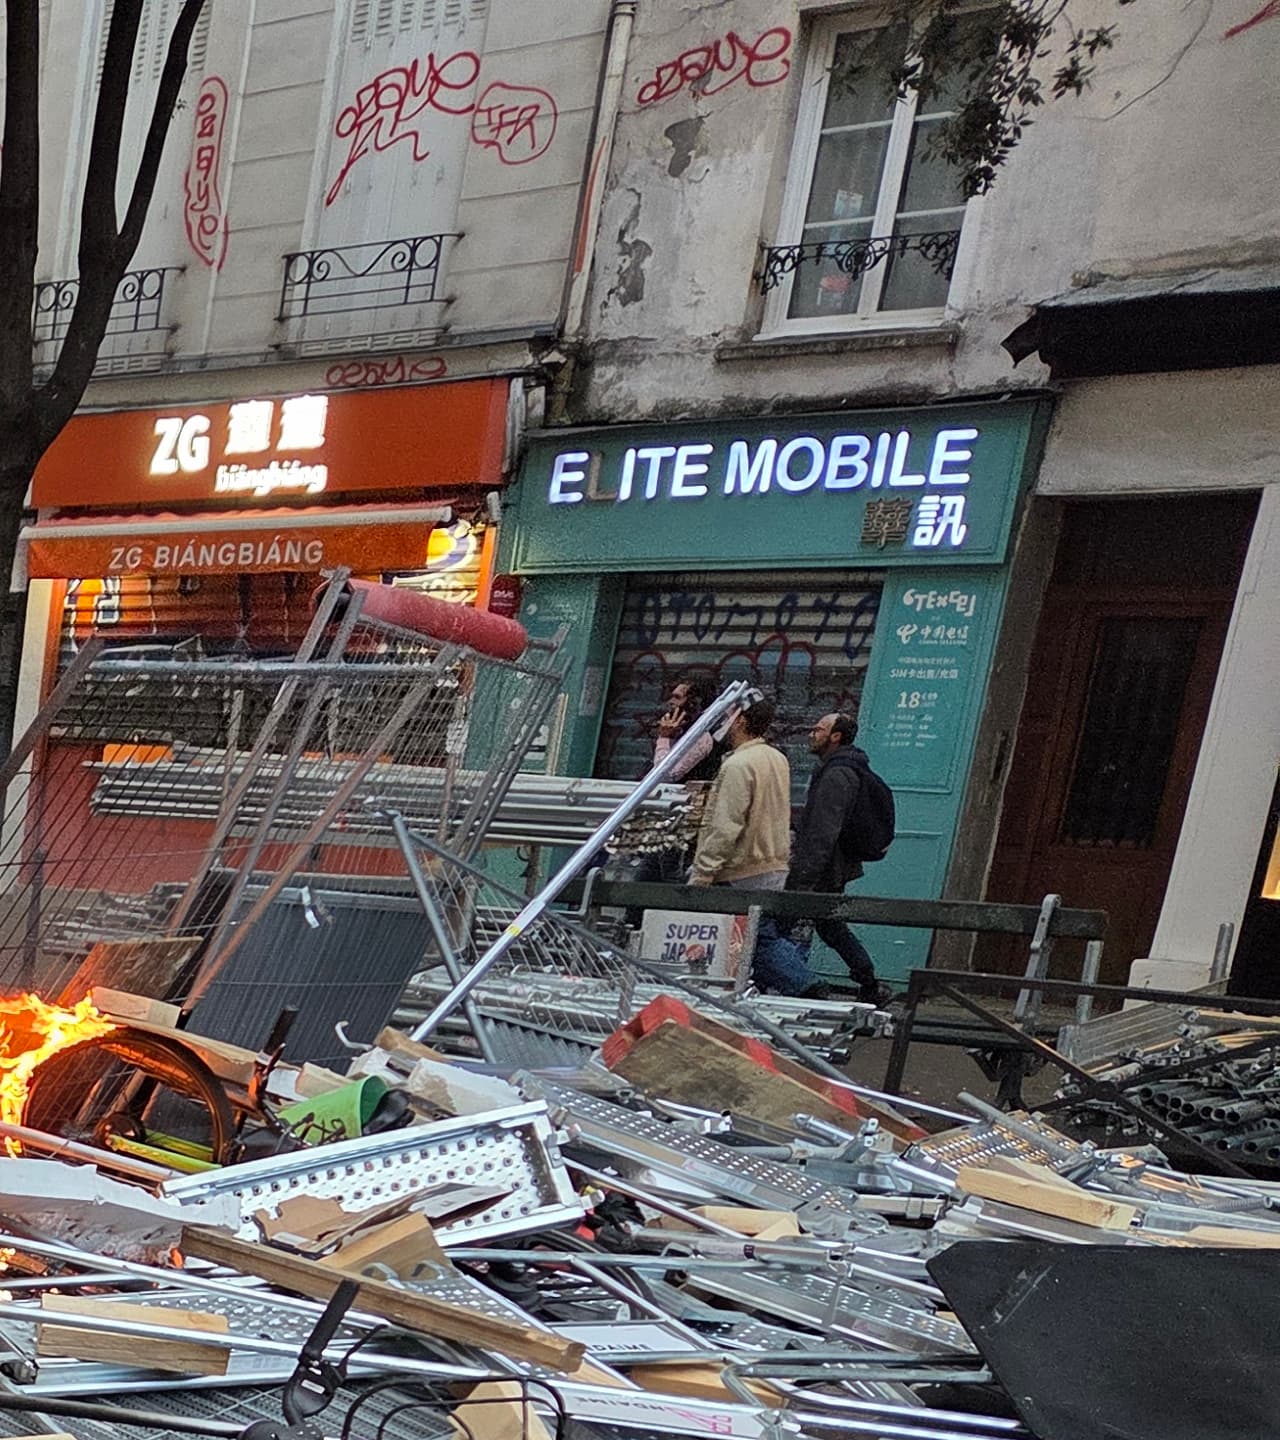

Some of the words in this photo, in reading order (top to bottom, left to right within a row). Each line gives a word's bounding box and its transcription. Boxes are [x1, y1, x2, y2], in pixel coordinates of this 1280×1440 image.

[151, 414, 211, 476] ZG
[549, 443, 714, 502] ELITE
[724, 429, 978, 494] MOBILE
[109, 547, 142, 569] ZG
[666, 923, 719, 940] SUPER
